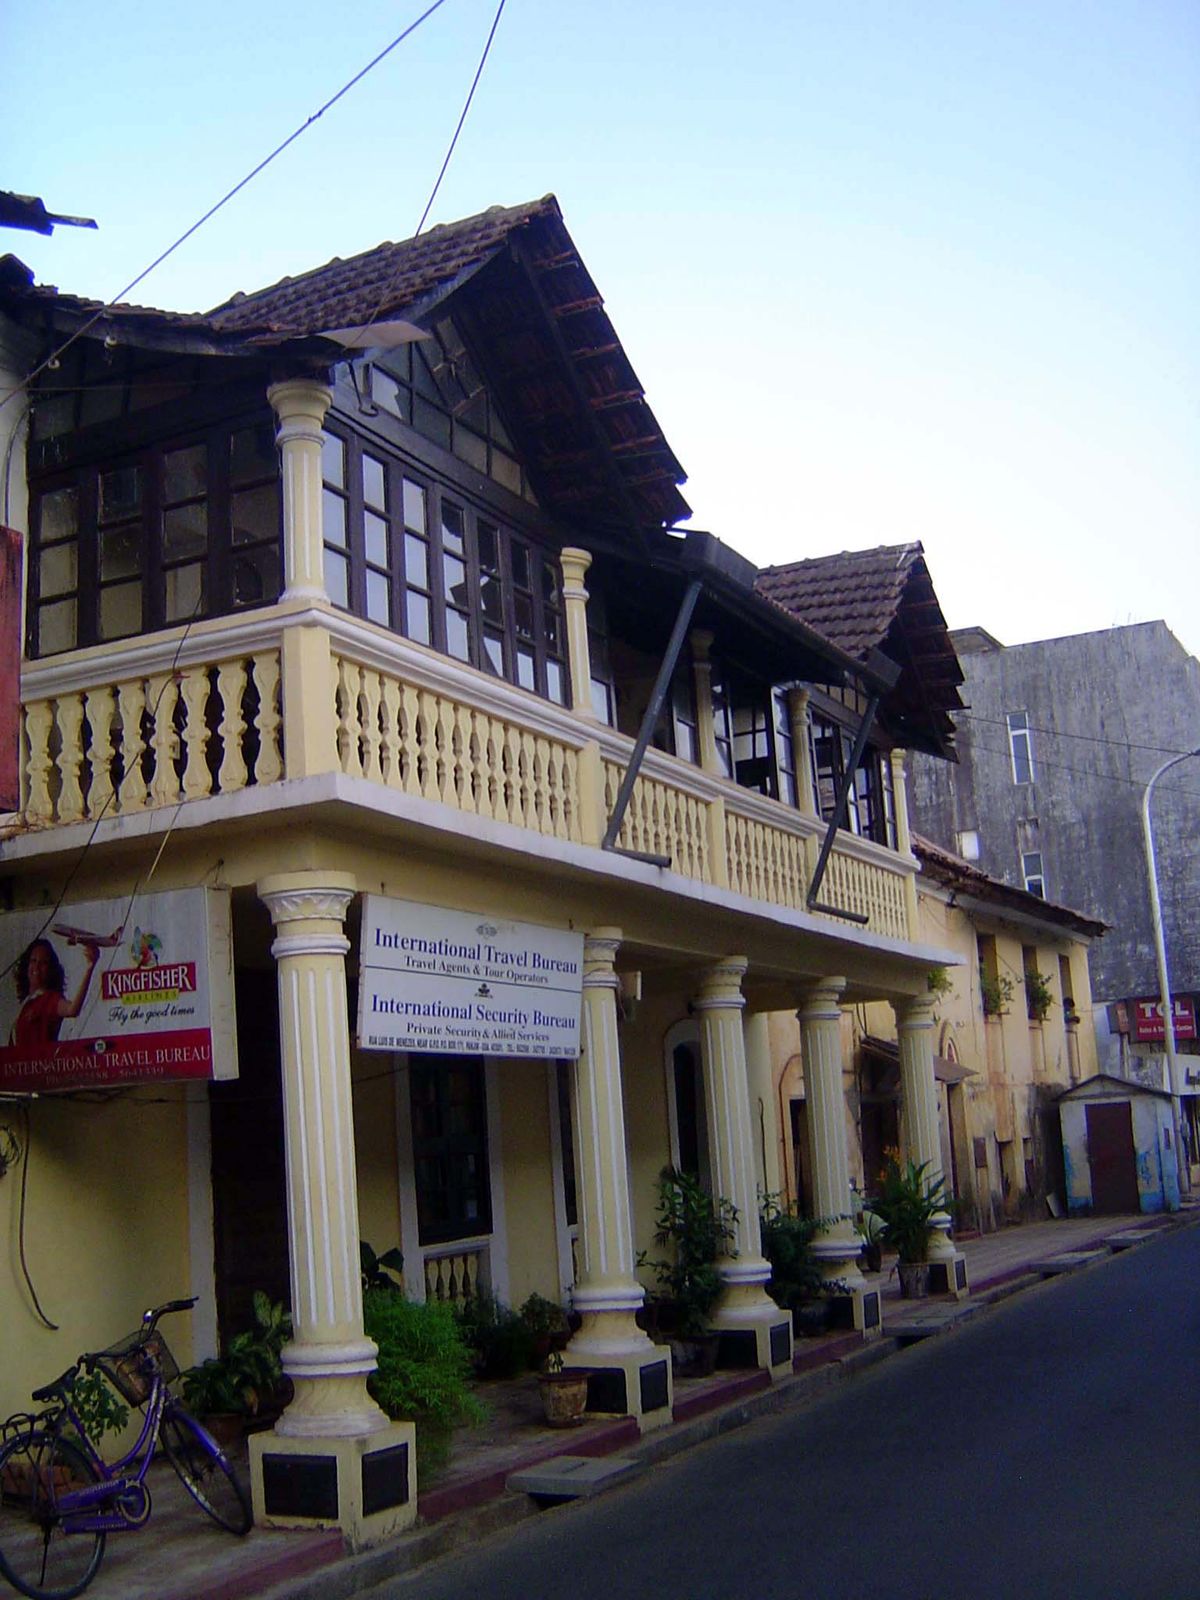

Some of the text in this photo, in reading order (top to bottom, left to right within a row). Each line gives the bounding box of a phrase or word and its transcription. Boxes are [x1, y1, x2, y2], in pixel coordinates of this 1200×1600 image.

[374, 928, 480, 960] International
[484, 945, 528, 967] Travel
[532, 952, 578, 974] Bureau
[108, 966, 192, 997] KINGFISHER
[404, 955, 549, 985] Travel Agents & Tour Operators
[109, 1003, 195, 1026] Fly the good times
[371, 994, 576, 1029] International Security Bureau
[407, 1022, 442, 1036] Private
[445, 1024, 482, 1041] Security
[491, 1029, 516, 1041] Allied
[517, 1029, 550, 1042] Services
[4, 1045, 210, 1076] INTERNATIONAL TRAVEL BUREAU
